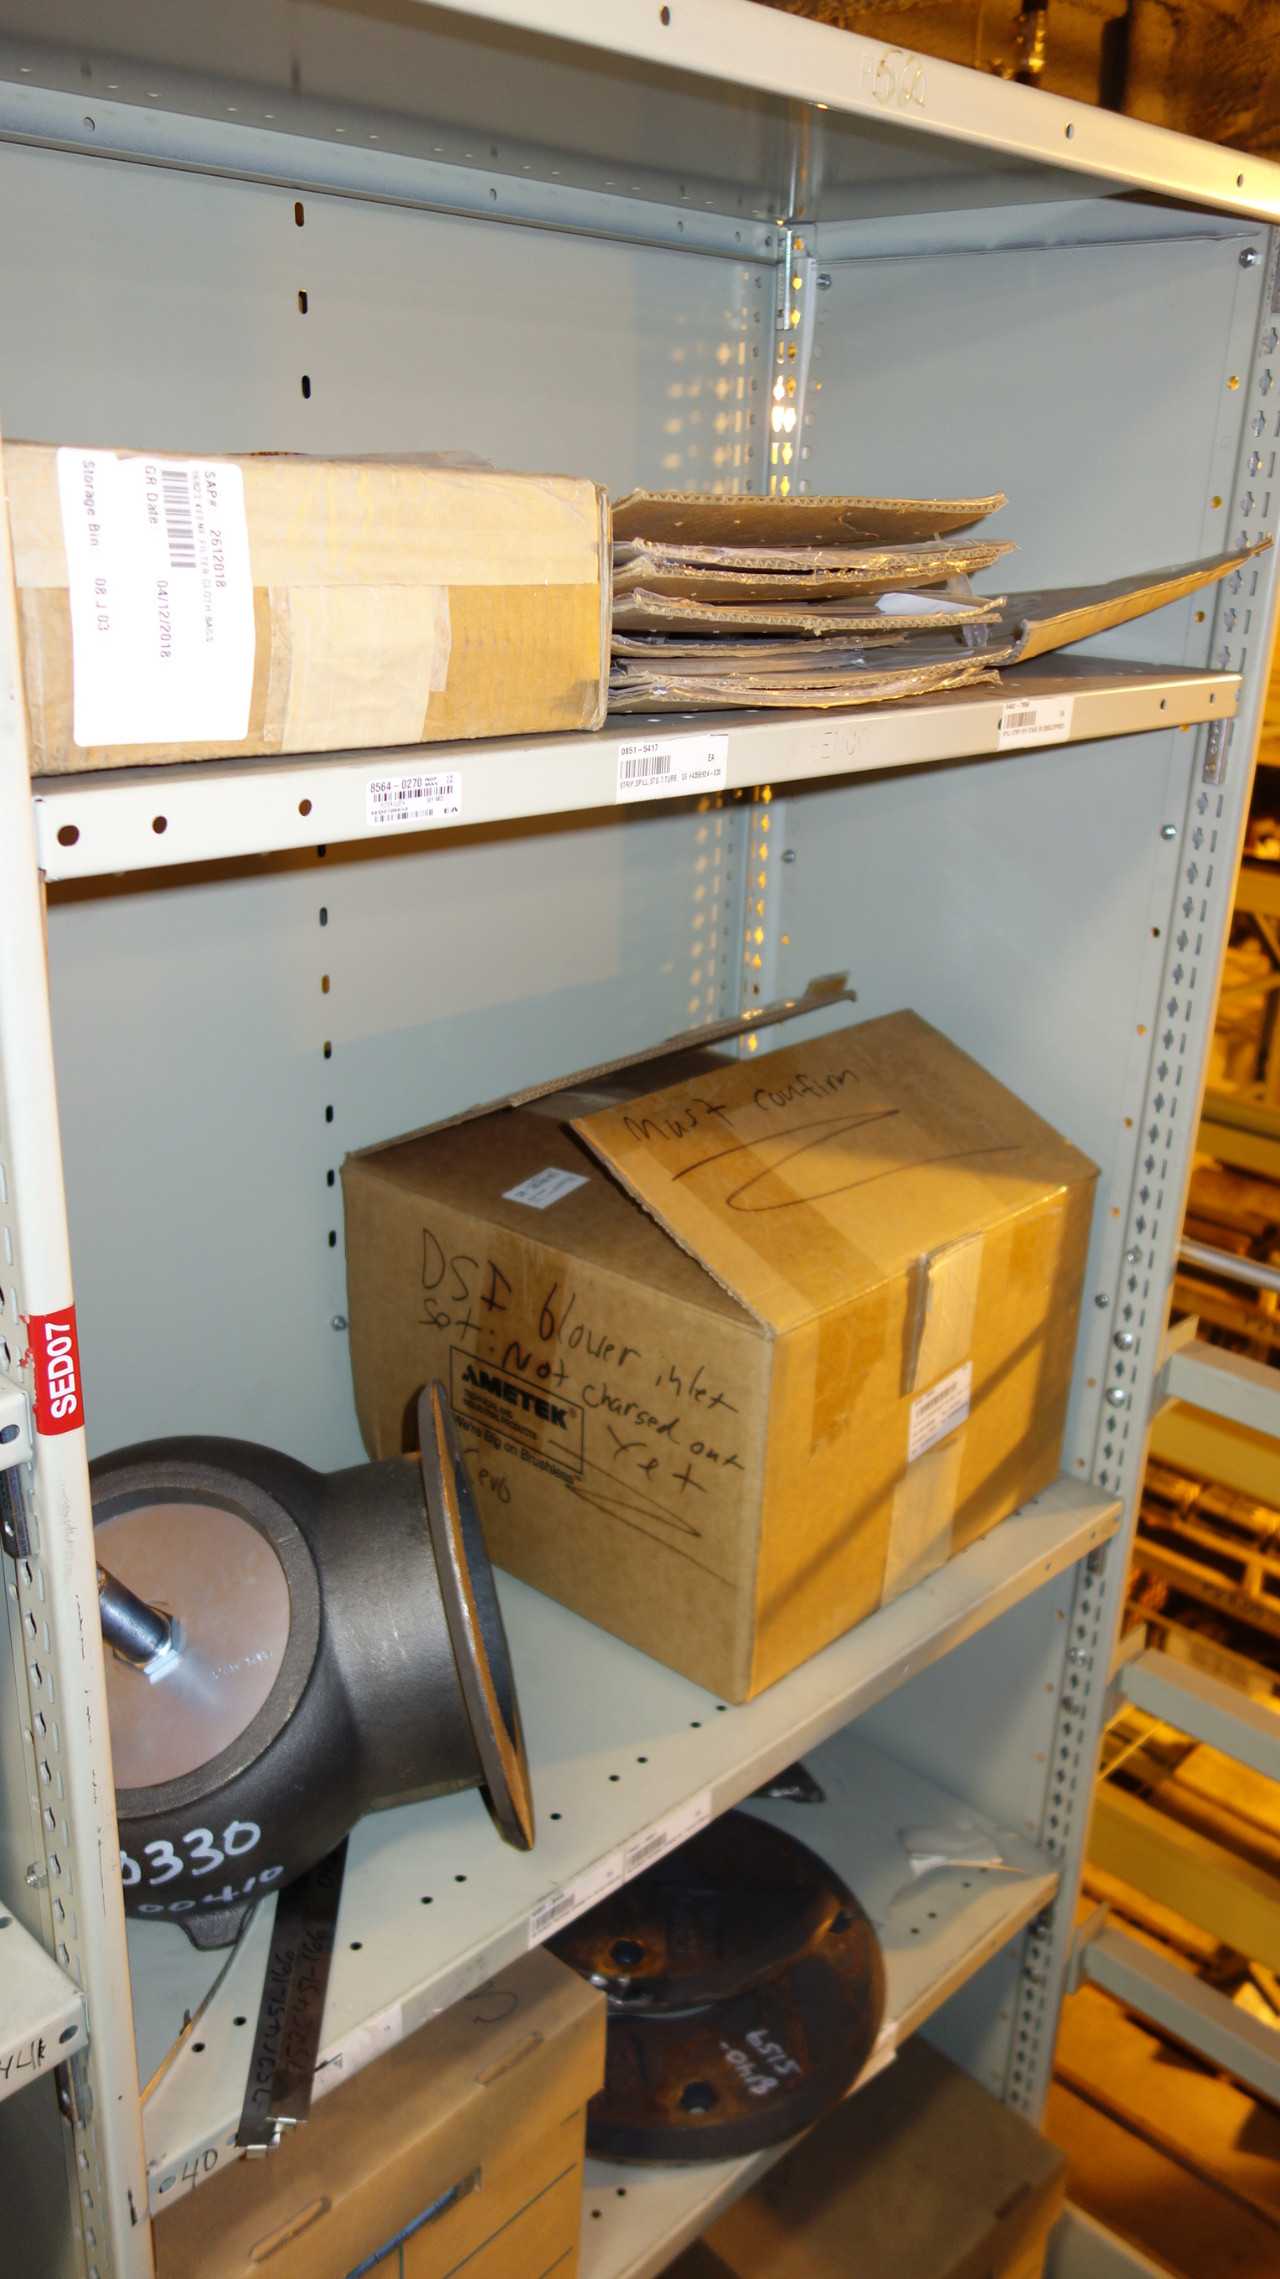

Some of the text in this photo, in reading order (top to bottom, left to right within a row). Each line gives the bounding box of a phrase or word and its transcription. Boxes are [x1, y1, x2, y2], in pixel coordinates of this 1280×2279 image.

[83, 460, 96, 516] Storage
[144, 465, 157, 485] GR
[156, 580, 172, 658] 04/12/2018
[209, 529, 227, 589] 2612018
[44, 1322, 78, 1419] SED07
